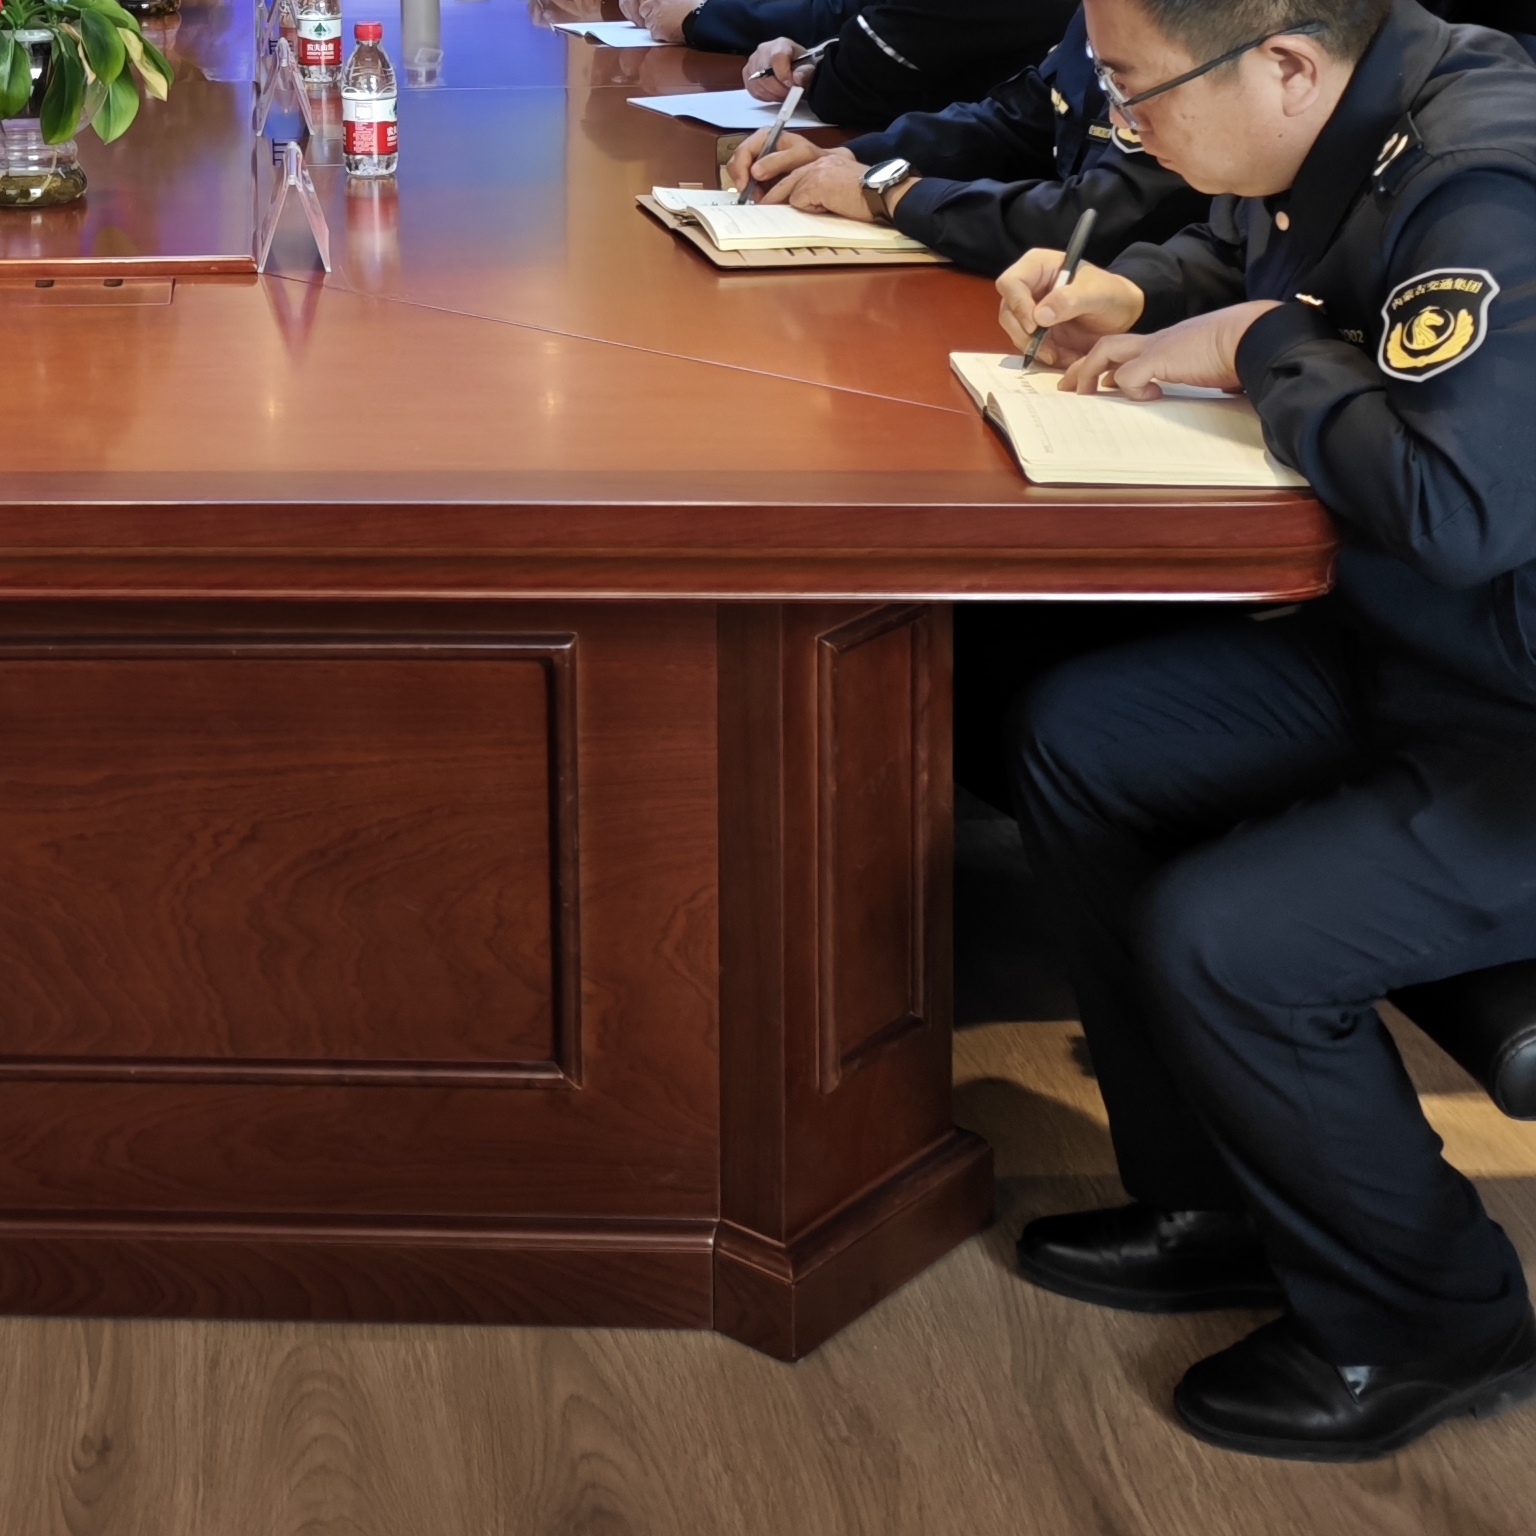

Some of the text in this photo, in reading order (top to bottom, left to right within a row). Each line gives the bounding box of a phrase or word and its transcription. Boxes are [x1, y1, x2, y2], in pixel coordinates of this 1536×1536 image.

[307, 43, 334, 52] 农夫山泉
[1391, 278, 1483, 311] 内蒙古交通集团
